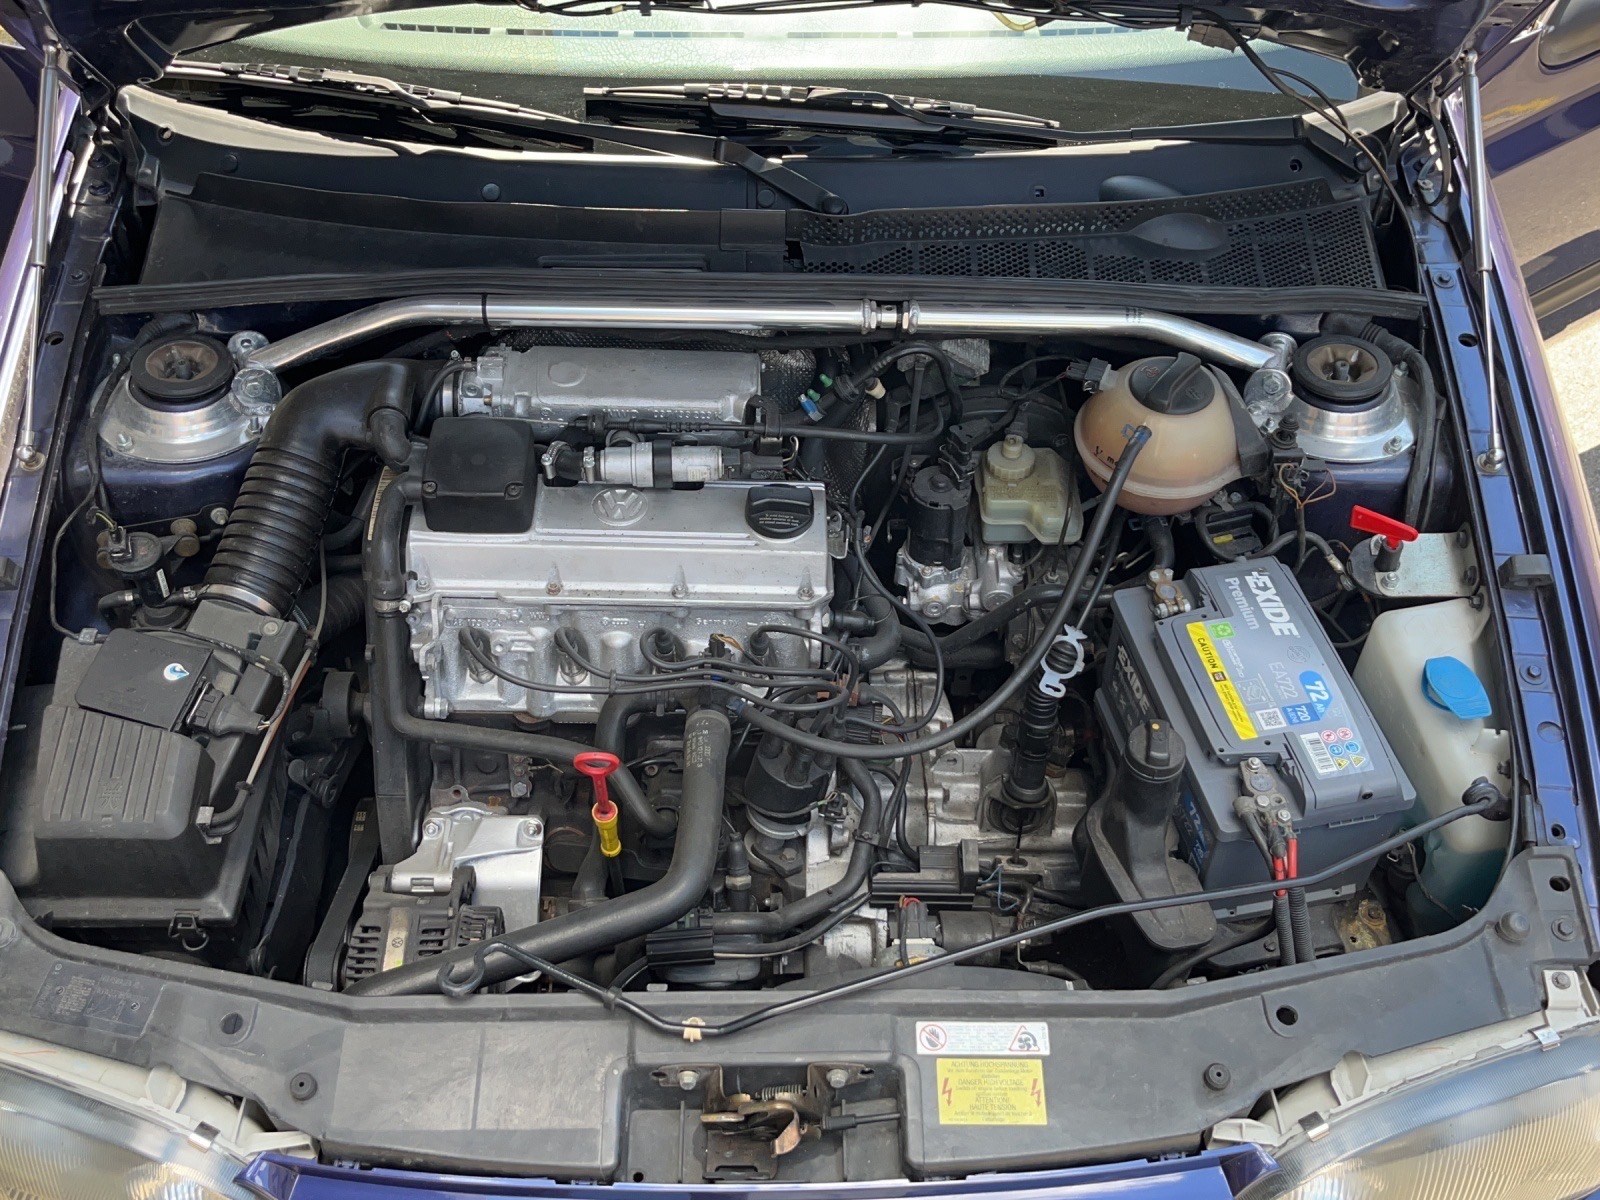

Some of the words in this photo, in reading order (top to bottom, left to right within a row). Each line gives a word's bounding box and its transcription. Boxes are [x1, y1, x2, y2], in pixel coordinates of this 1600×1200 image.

[1224, 576, 1260, 630] Premium
[1245, 573, 1299, 637] EXIDE
[1197, 637, 1219, 669] CAUTION
[1117, 645, 1150, 714] EXIDE
[1269, 662, 1298, 699] EA722
[1305, 680, 1329, 701] 72
[1297, 705, 1310, 721] 720
